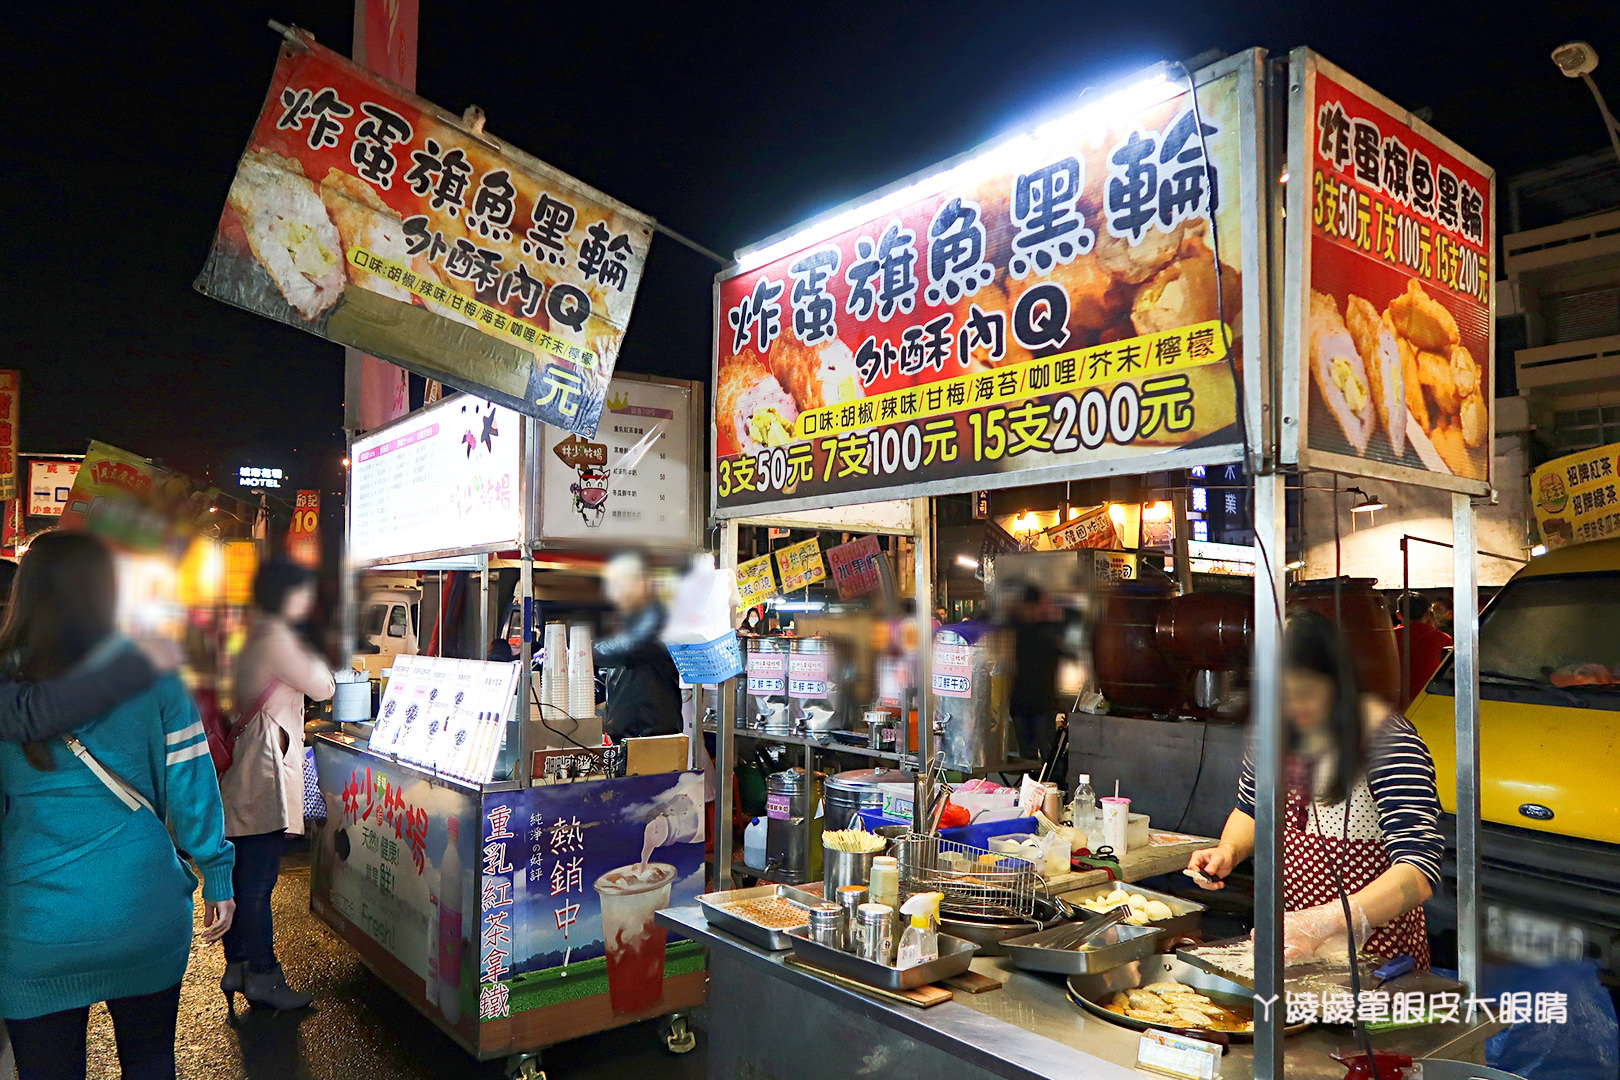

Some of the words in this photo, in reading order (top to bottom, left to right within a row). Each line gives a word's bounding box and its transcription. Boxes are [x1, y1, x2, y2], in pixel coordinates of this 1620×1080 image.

[280, 86, 635, 293] 炸蛋旗魚黑輪
[729, 108, 1220, 353] 炸蛋旗魚黑輪
[1319, 101, 1484, 247] 炸蛋旗魚黑輪
[1314, 176, 1371, 251] 3支50元
[1376, 202, 1431, 279] 7支100元
[1435, 233, 1488, 304] 15支200元
[536, 367, 583, 418] 元
[718, 450, 813, 497] 3支50元
[822, 417, 957, 483] 7支100元
[969, 375, 1193, 462] 15支200元
[240, 478, 281, 488] MOTEL
[294, 511, 318, 533] 10
[529, 812, 543, 882] 純淨の好評
[550, 815, 584, 978] 熱銷中!
[480, 805, 514, 1019] 重乳紅茶拿鐵
